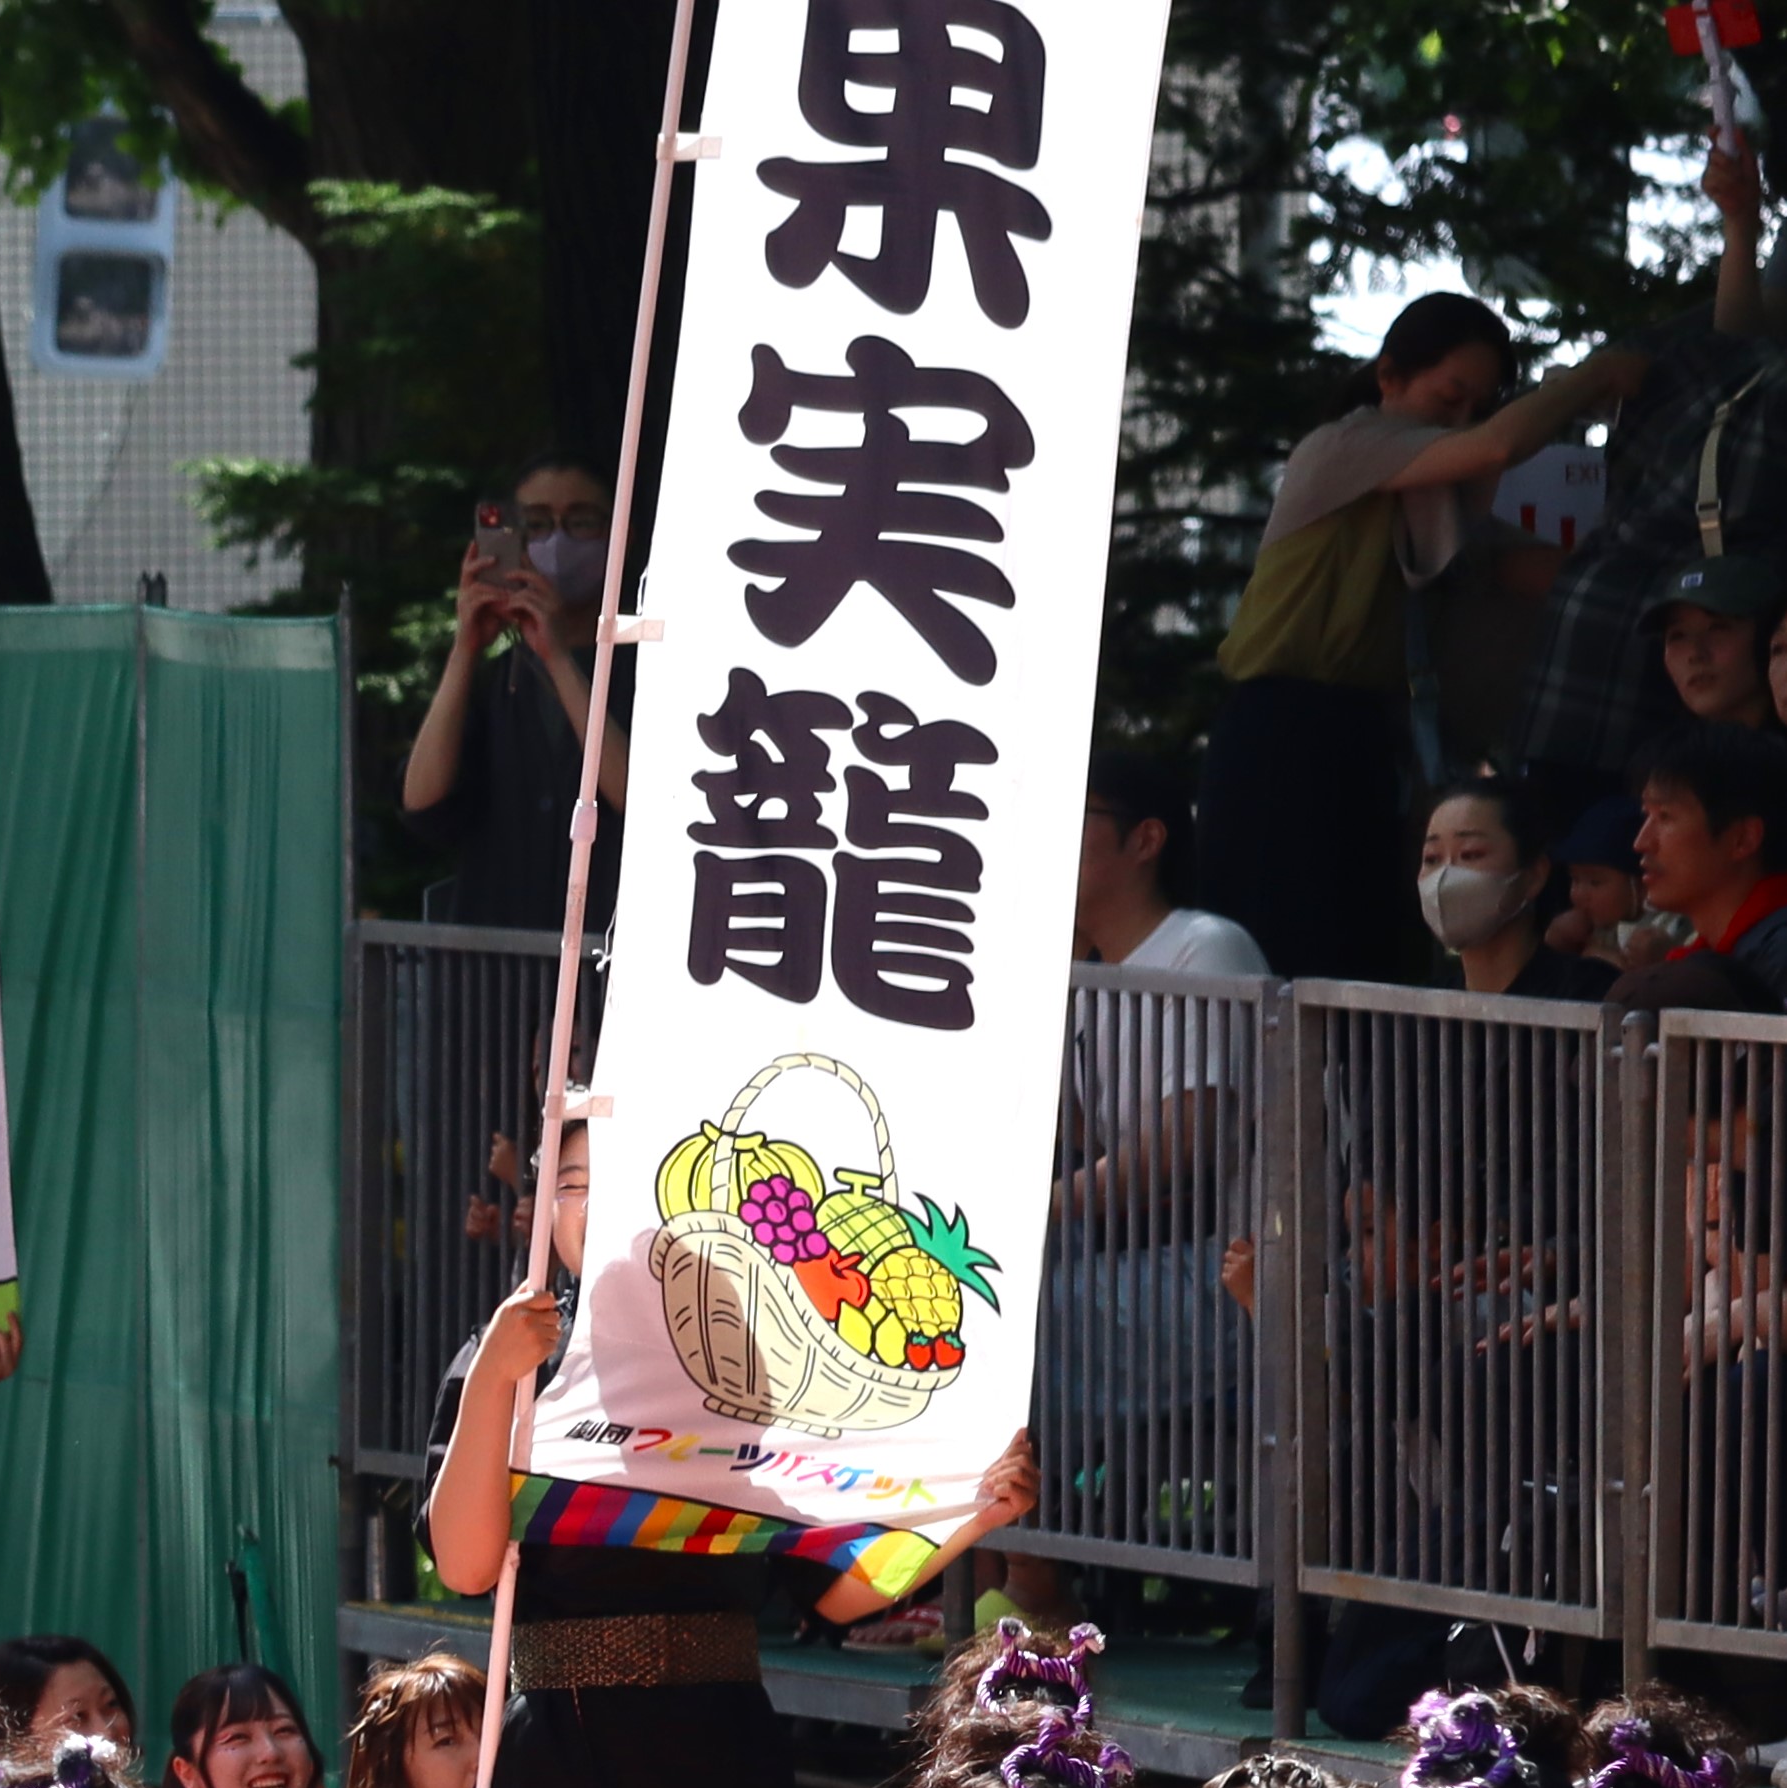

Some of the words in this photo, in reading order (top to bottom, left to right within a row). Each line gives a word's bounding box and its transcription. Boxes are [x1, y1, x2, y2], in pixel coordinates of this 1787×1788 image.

[686, 0, 1053, 1031] 果実籠
[564, 1418, 938, 1509] 劇団フルーツバスケット
